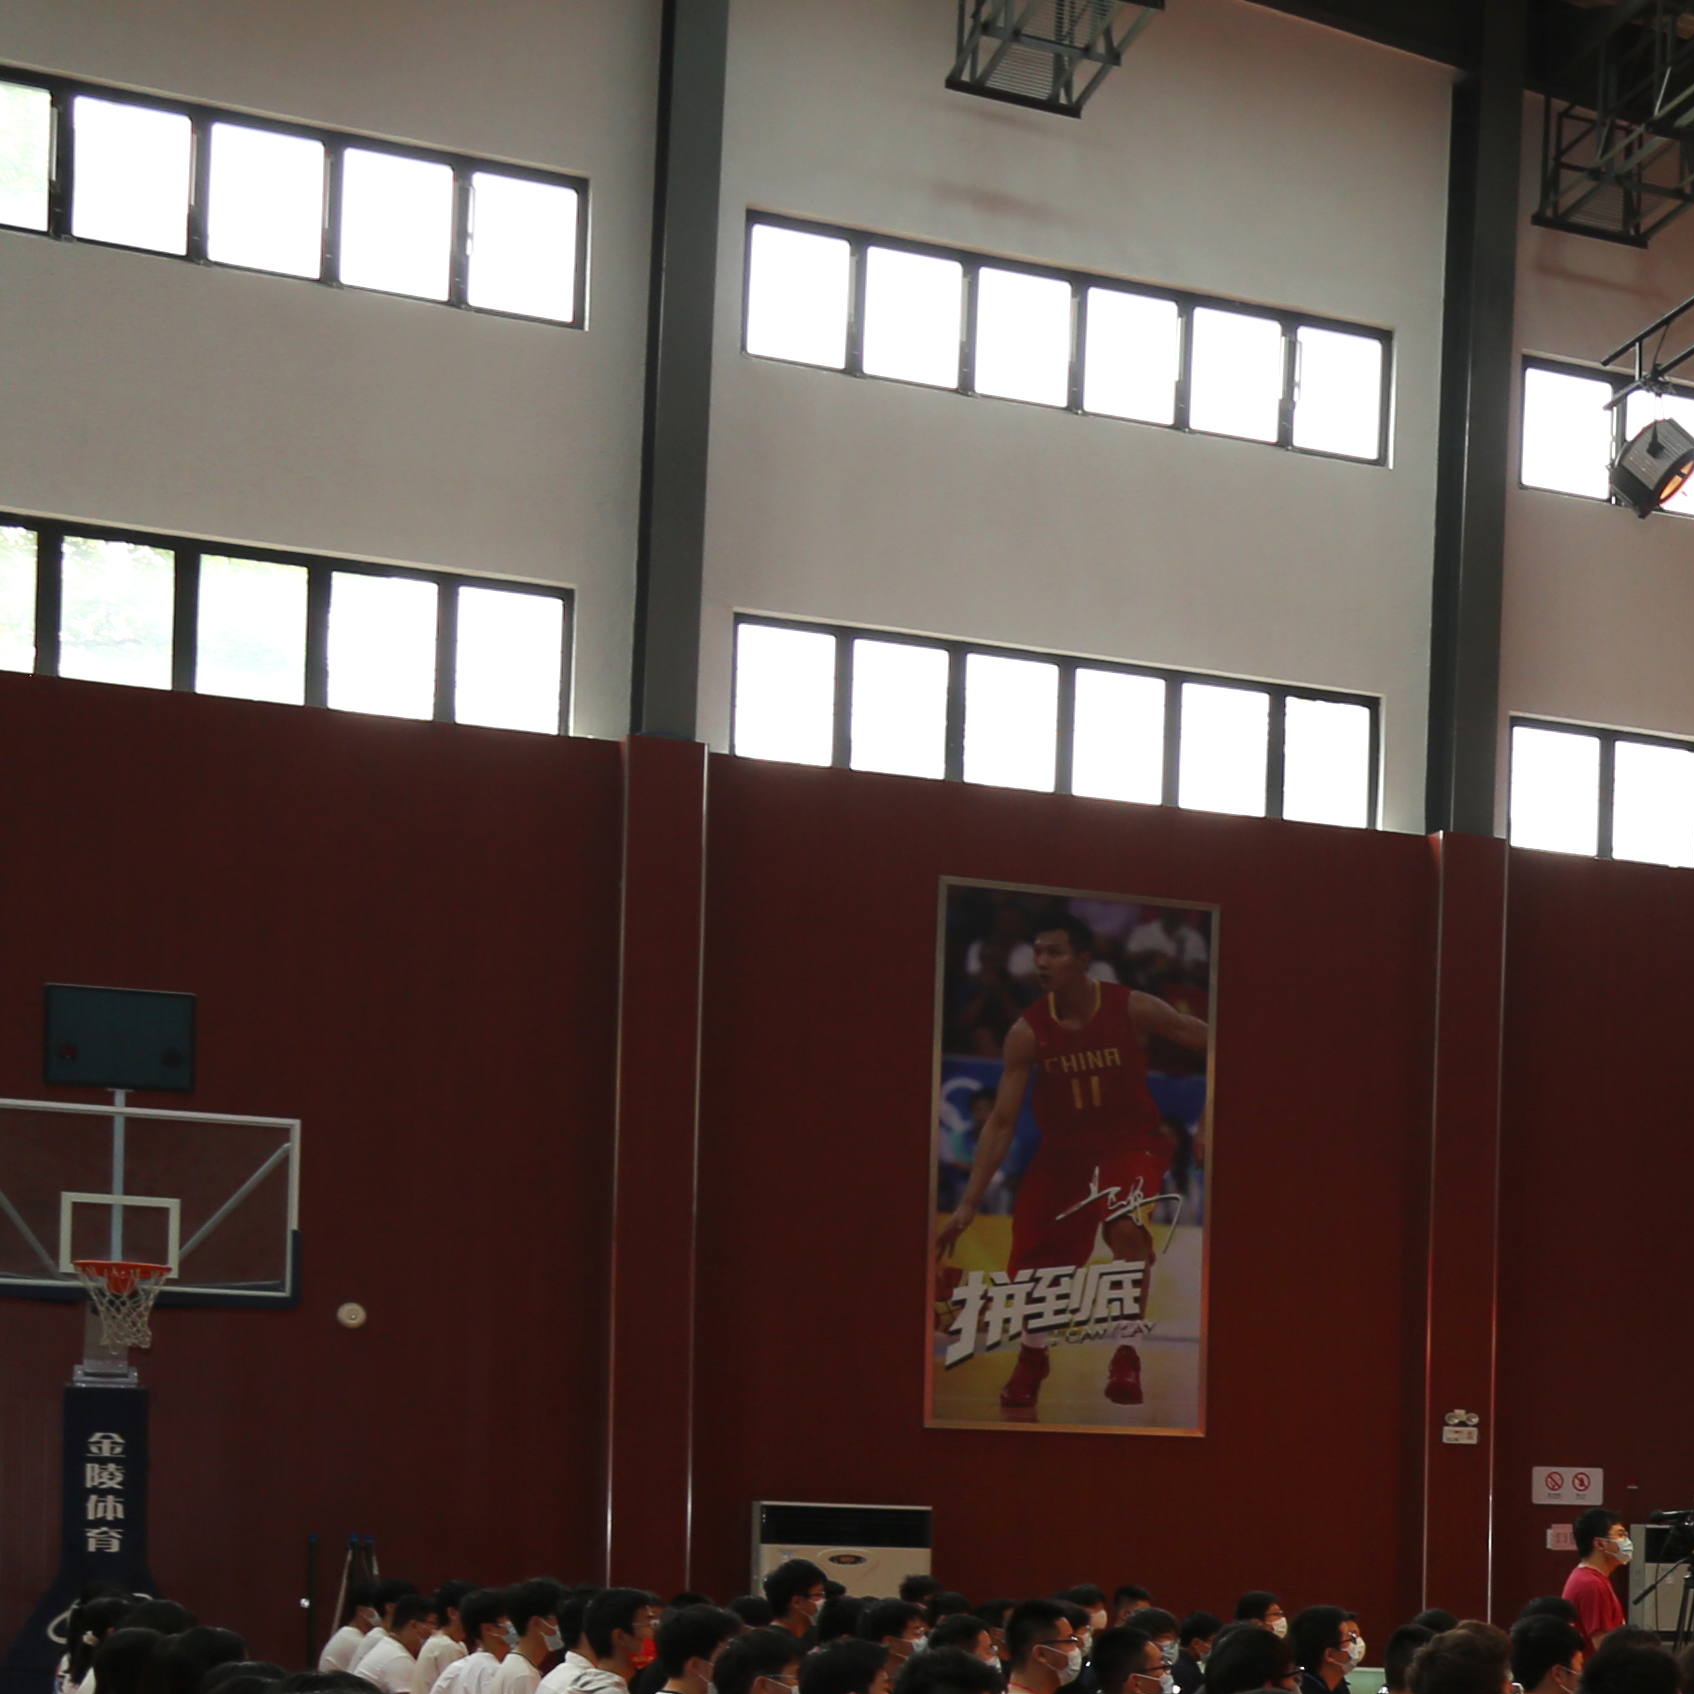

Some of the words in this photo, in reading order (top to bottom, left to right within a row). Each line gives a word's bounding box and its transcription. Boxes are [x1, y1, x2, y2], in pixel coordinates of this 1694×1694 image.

[1044, 1047, 1122, 1073] CHINA
[1070, 1075, 1101, 1109] 11
[944, 1259, 1146, 1368] 拼到底
[84, 1431, 125, 1554] 金陵体育
